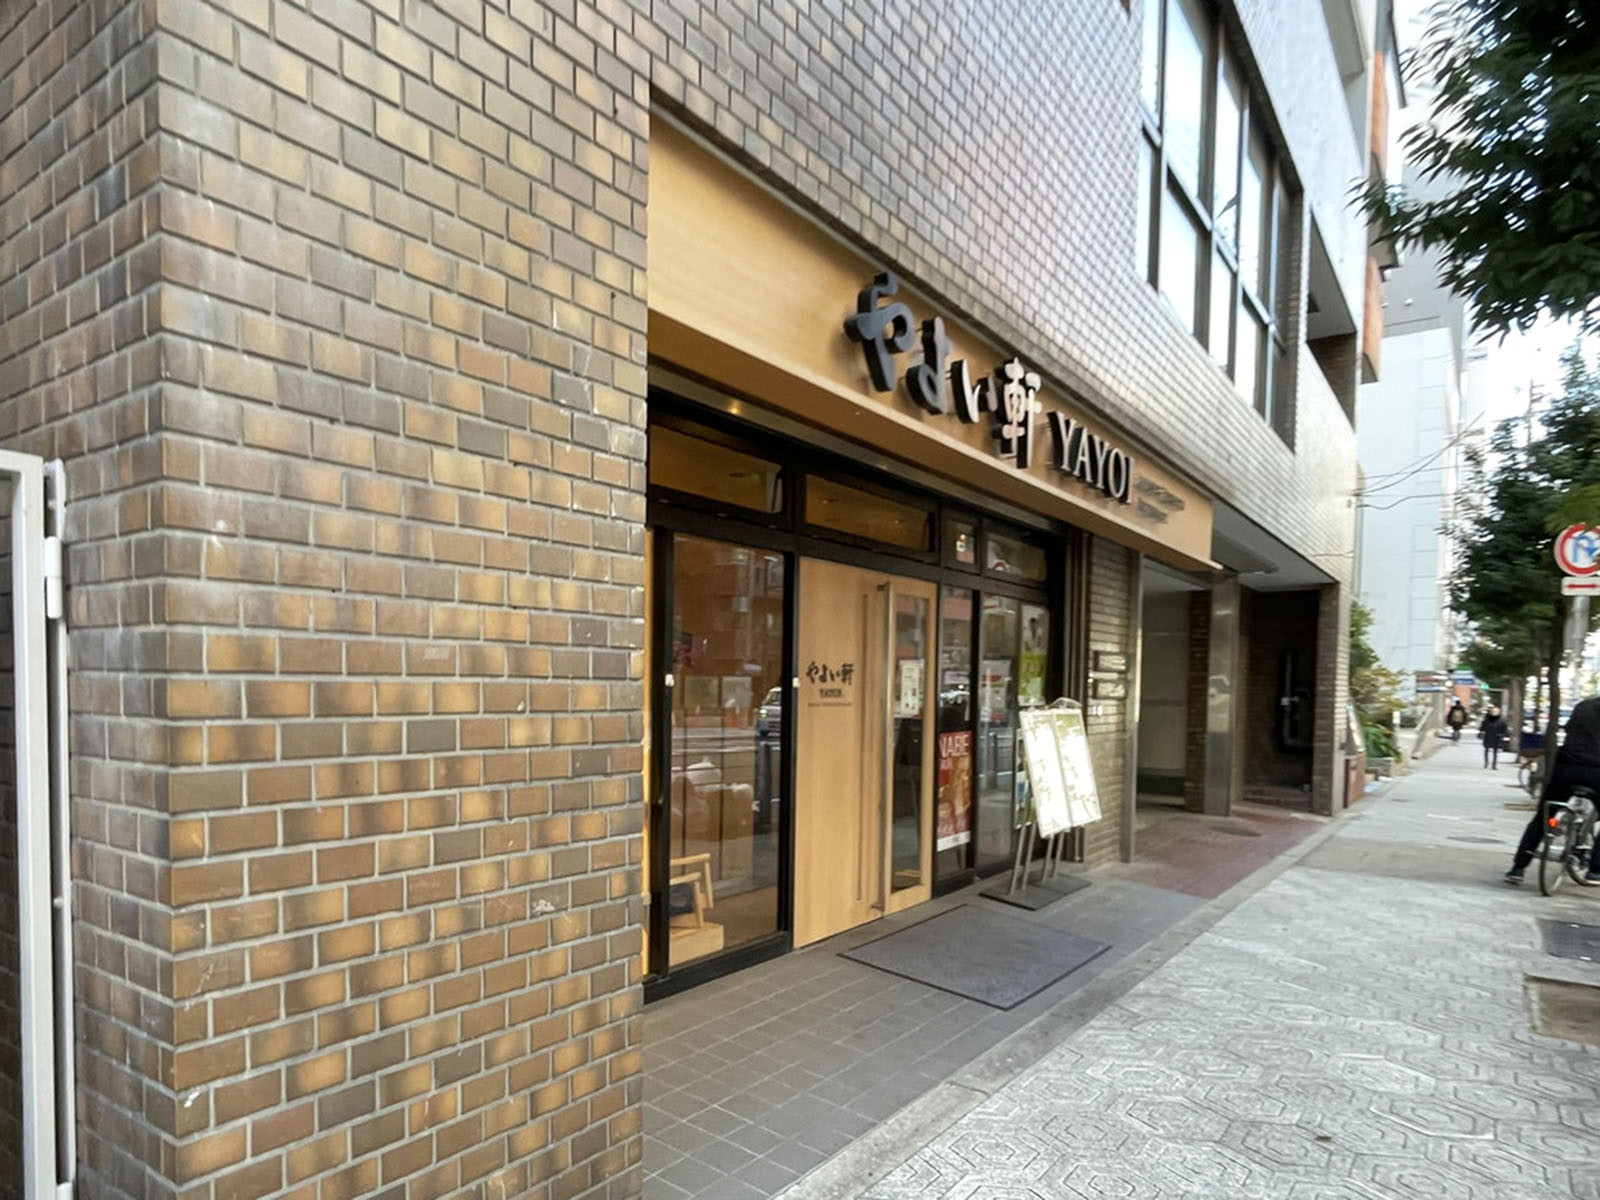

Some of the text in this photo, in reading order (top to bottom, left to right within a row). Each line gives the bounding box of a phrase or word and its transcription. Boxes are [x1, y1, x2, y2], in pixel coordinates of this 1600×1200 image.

[844, 270, 1043, 470] やよい軒
[1047, 410, 1136, 505] YAYOI
